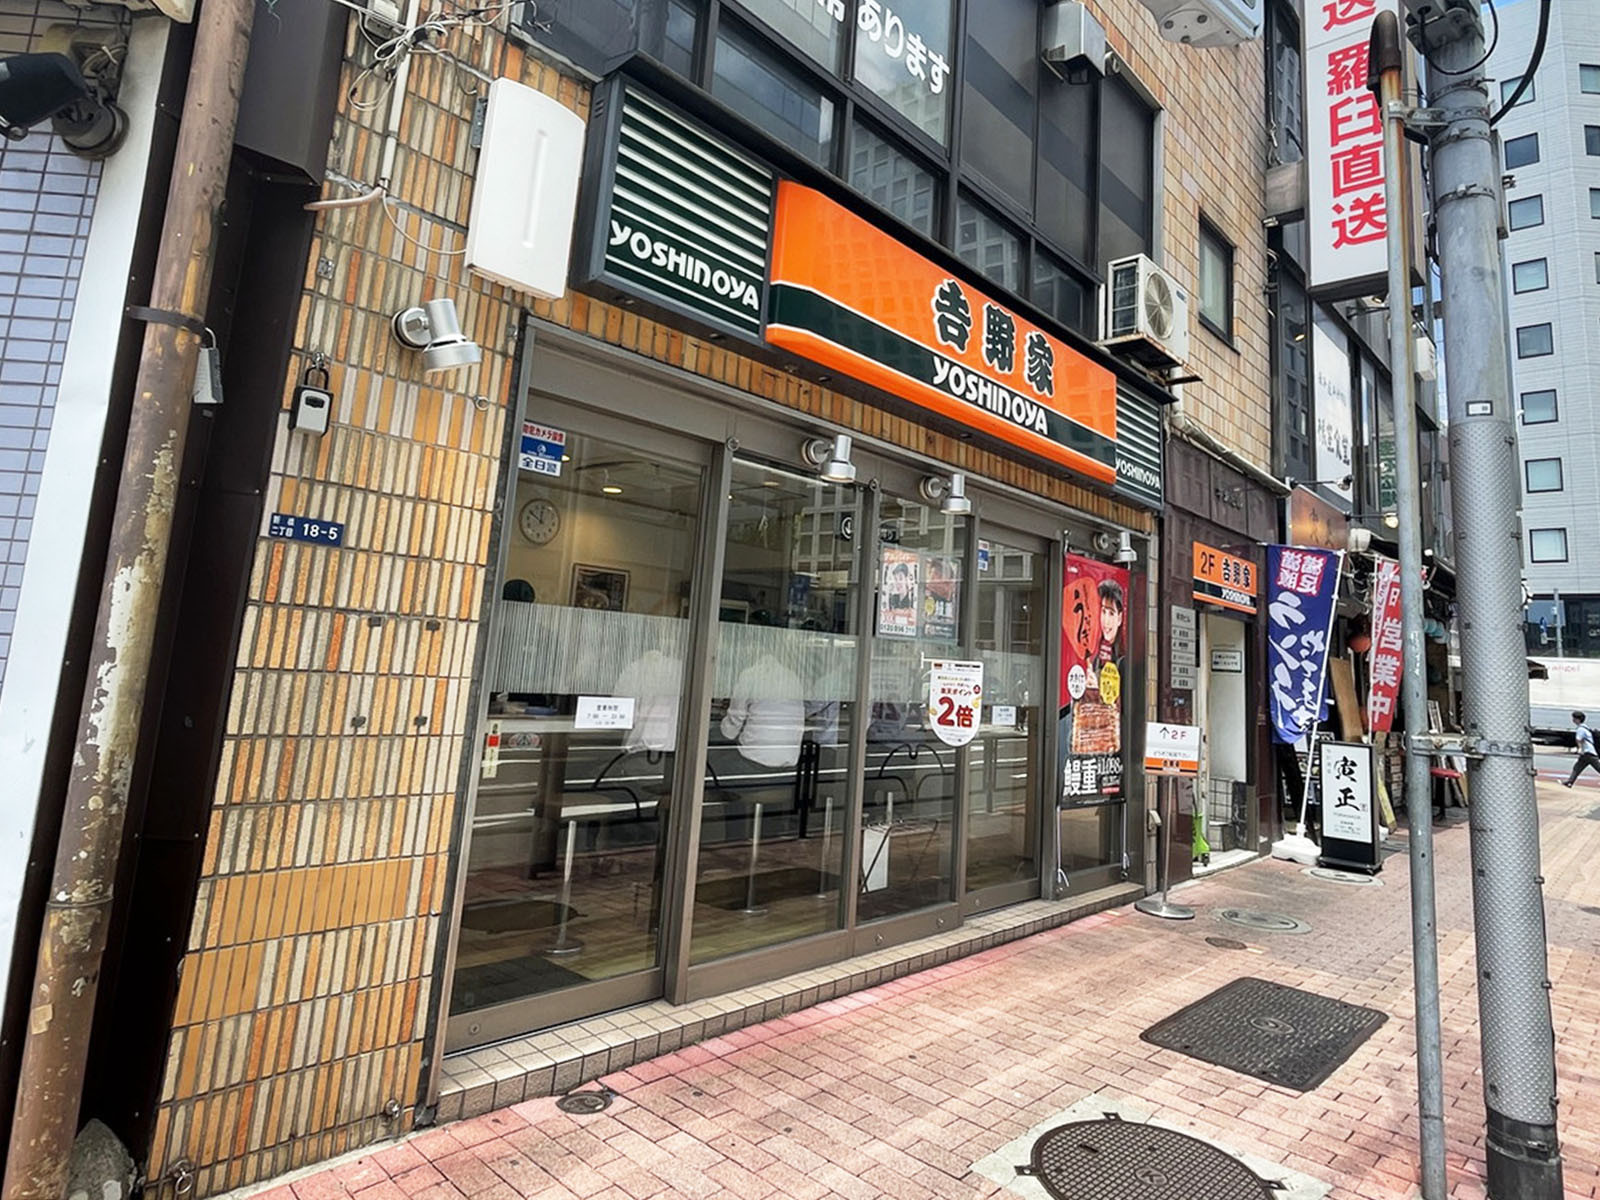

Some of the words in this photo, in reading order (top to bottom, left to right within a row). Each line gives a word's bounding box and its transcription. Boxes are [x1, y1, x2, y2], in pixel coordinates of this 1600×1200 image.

[610, 219, 761, 310] YOSHINOYA
[931, 279, 1055, 398] 吉野家
[932, 355, 1050, 435] YOSHINOYA
[303, 523, 338, 540] 18-5
[1200, 551, 1215, 576] 2F
[937, 696, 974, 728] 2倍
[1171, 729, 1187, 740] 2F
[1063, 758, 1098, 797] 鰻重
